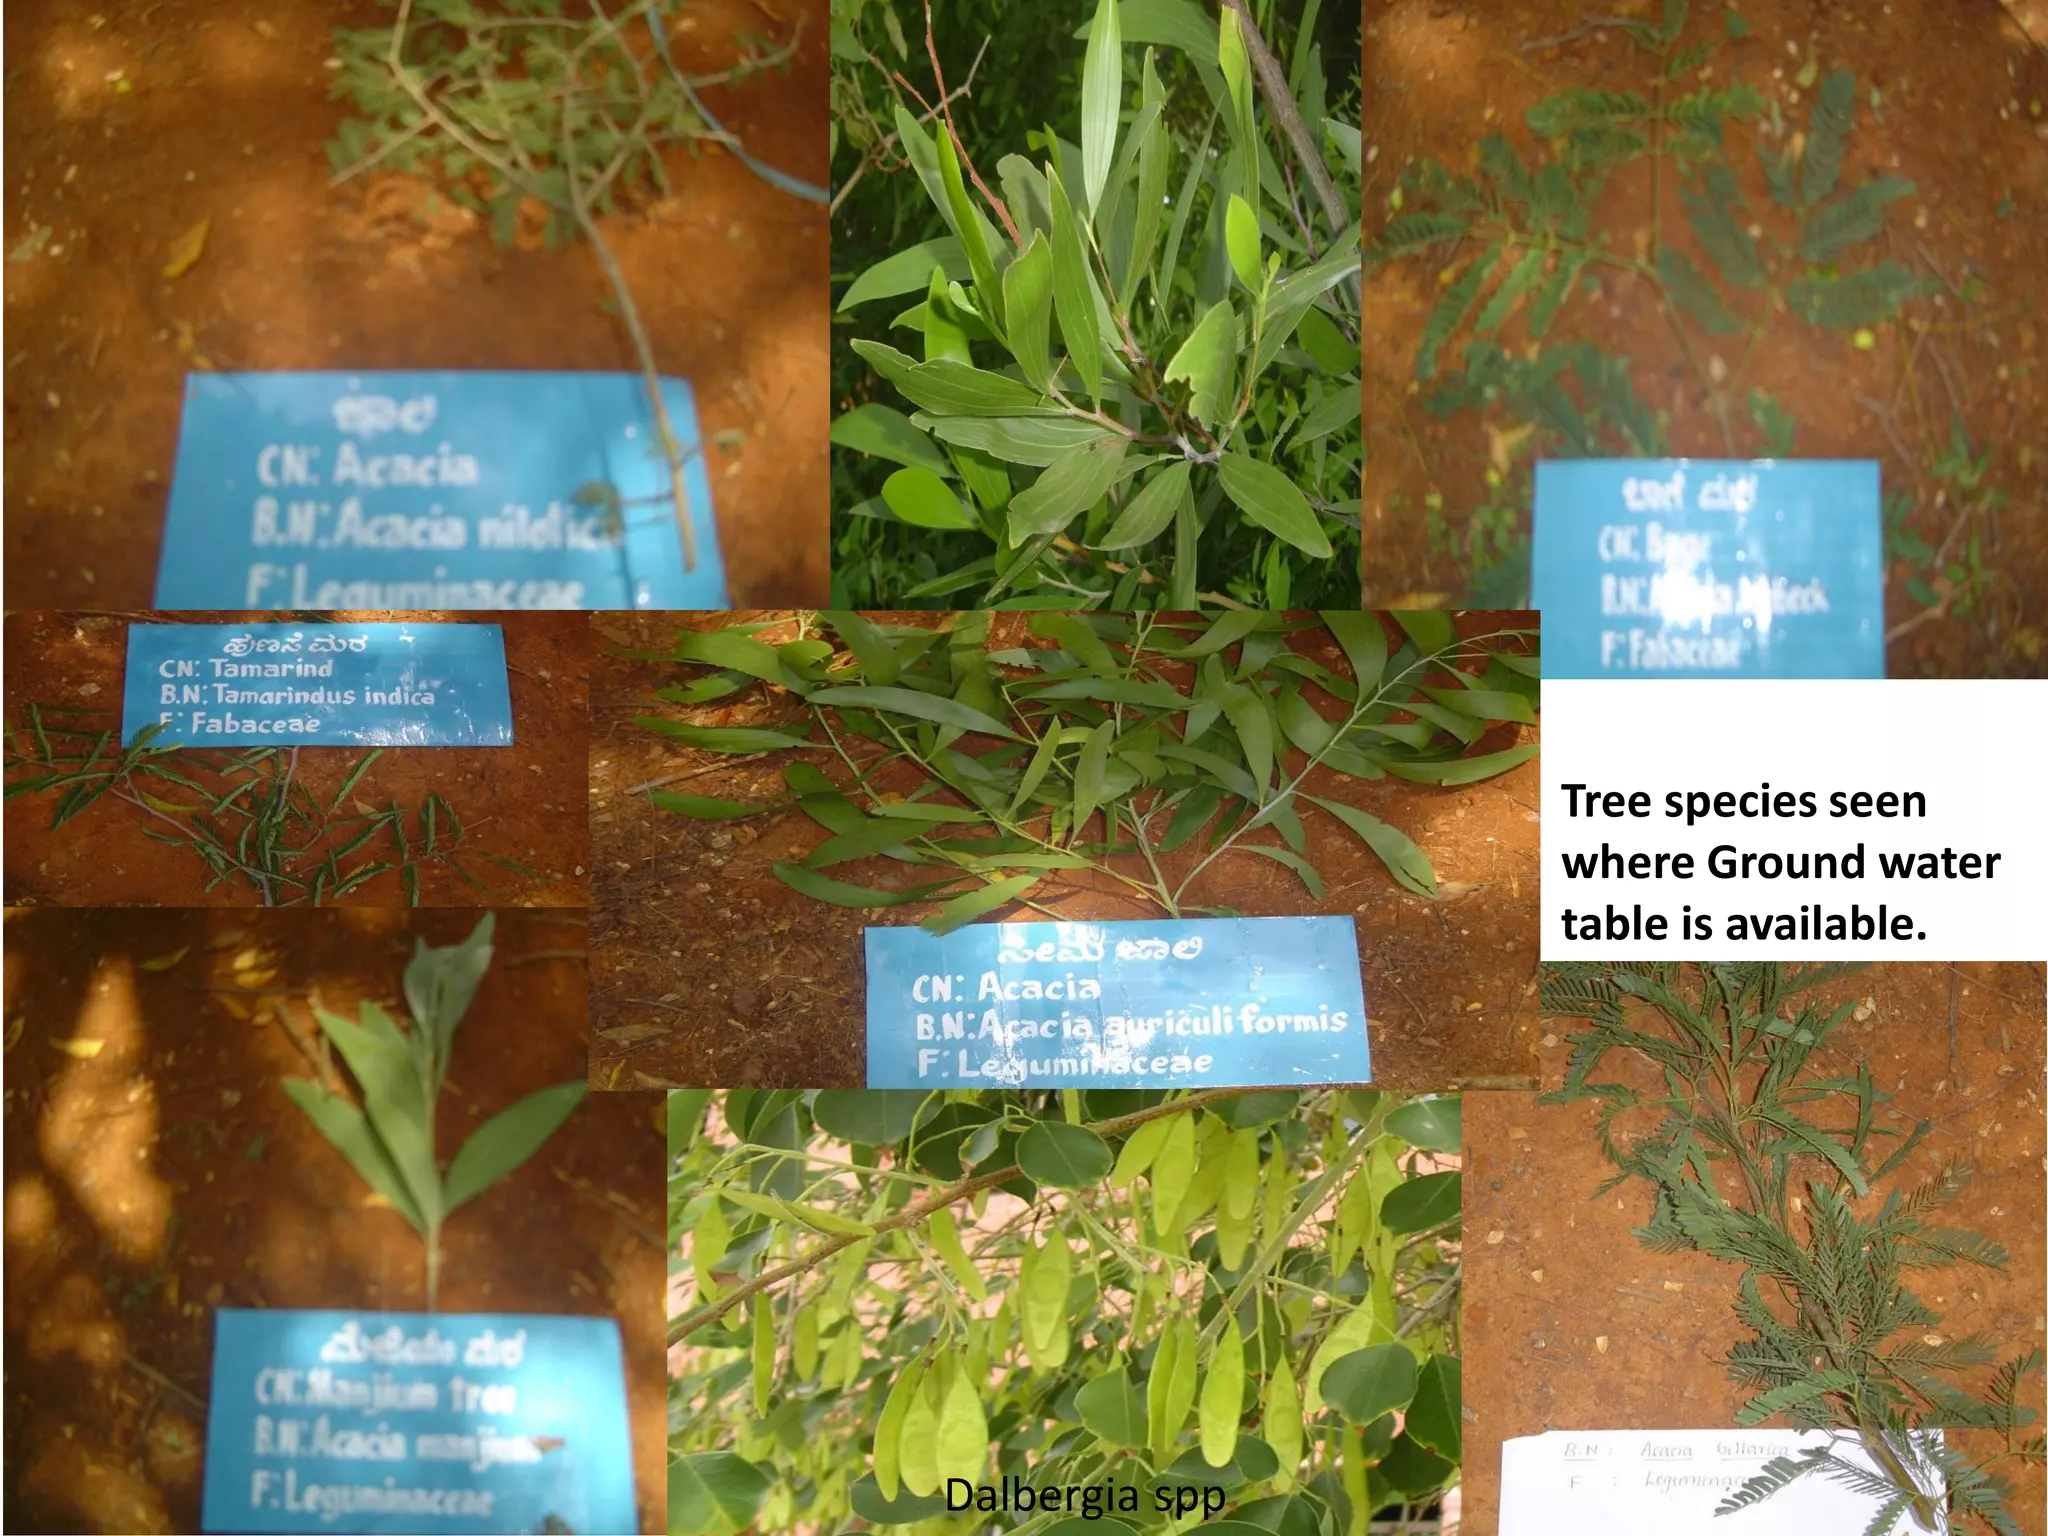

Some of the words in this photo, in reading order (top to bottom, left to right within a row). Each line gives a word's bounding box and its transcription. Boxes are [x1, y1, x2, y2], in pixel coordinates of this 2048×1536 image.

[332, 441, 479, 487] Acacia
[332, 498, 466, 550] Acacia
[308, 633, 370, 654] ಮರ
[207, 657, 334, 679] Tamarind
[211, 682, 356, 706] Tamarindus
[363, 686, 436, 706] indica
[191, 711, 321, 734] Fabaceae
[978, 970, 1101, 1002] Acacia
[978, 1009, 1092, 1042] Acacia
[957, 1046, 1214, 1083] Leguminaceae
[448, 1375, 518, 1416] tree
[311, 1413, 407, 1461] Acacia
[1640, 1440, 1693, 1458] Acacia
[284, 1465, 497, 1521] Leguminaceae
[1569, 1475, 1584, 1490] F
